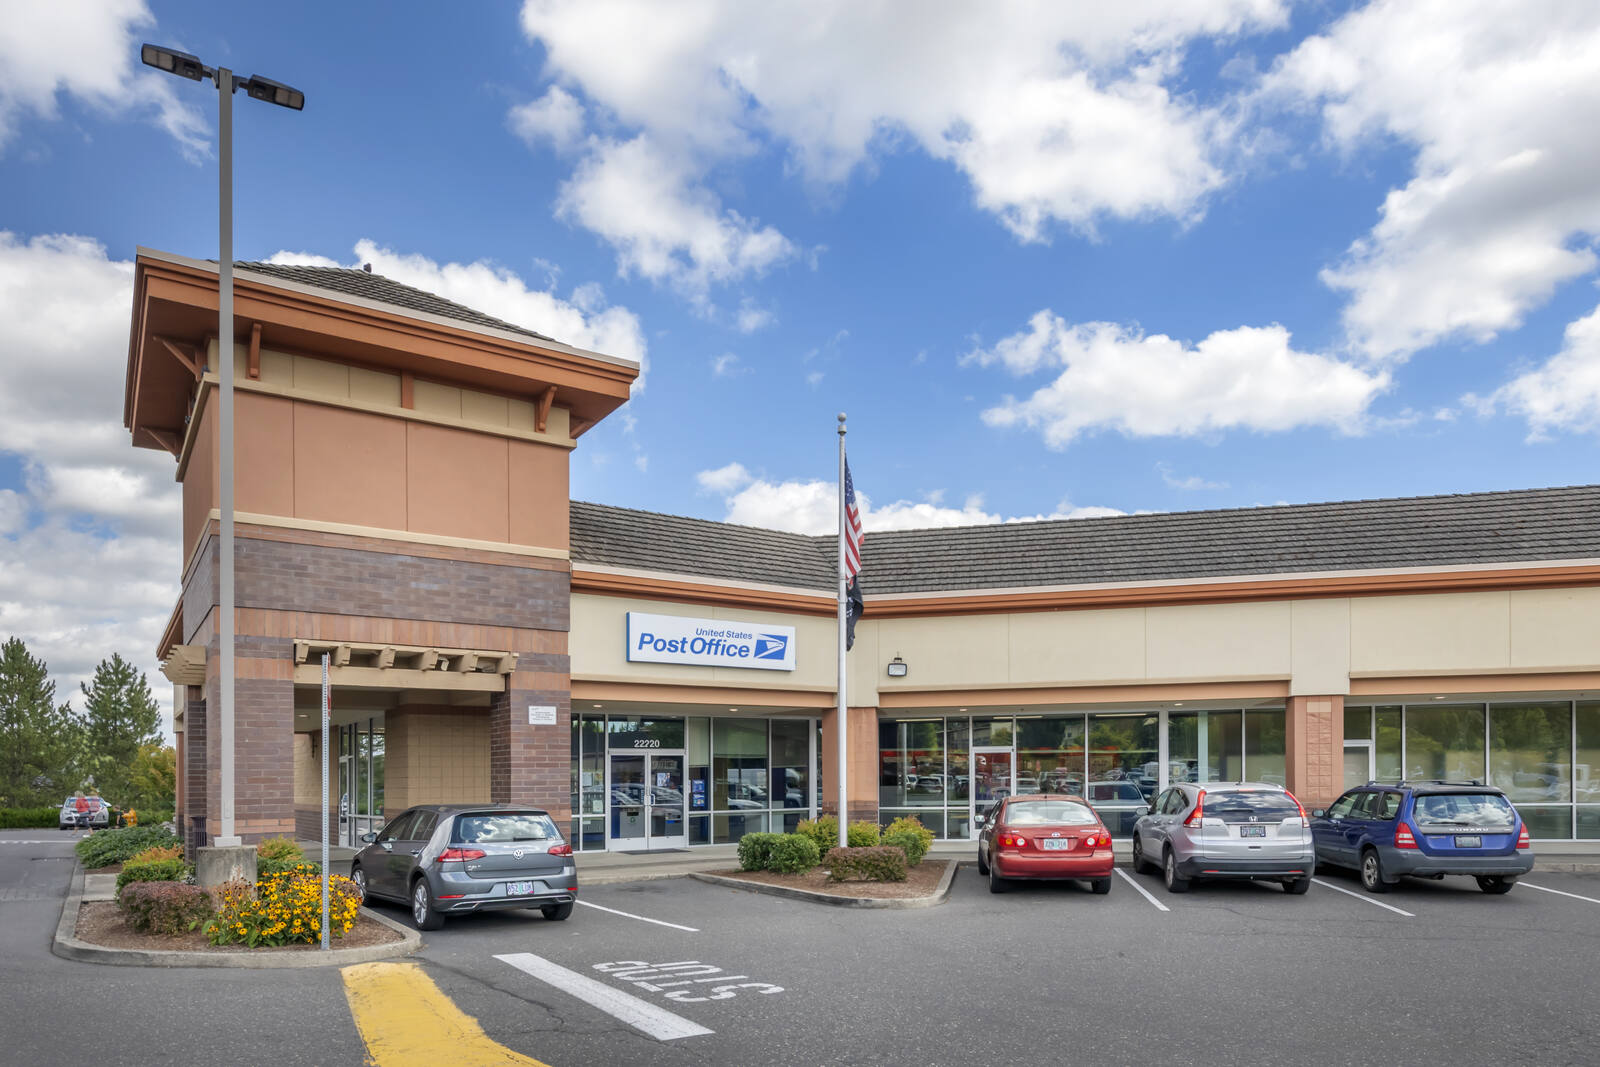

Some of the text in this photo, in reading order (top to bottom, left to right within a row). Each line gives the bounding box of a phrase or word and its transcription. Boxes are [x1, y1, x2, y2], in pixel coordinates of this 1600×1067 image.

[695, 628, 752, 639] United States
[638, 632, 750, 658] Post Office
[634, 740, 660, 748] 22220
[592, 961, 785, 1002] STOP
